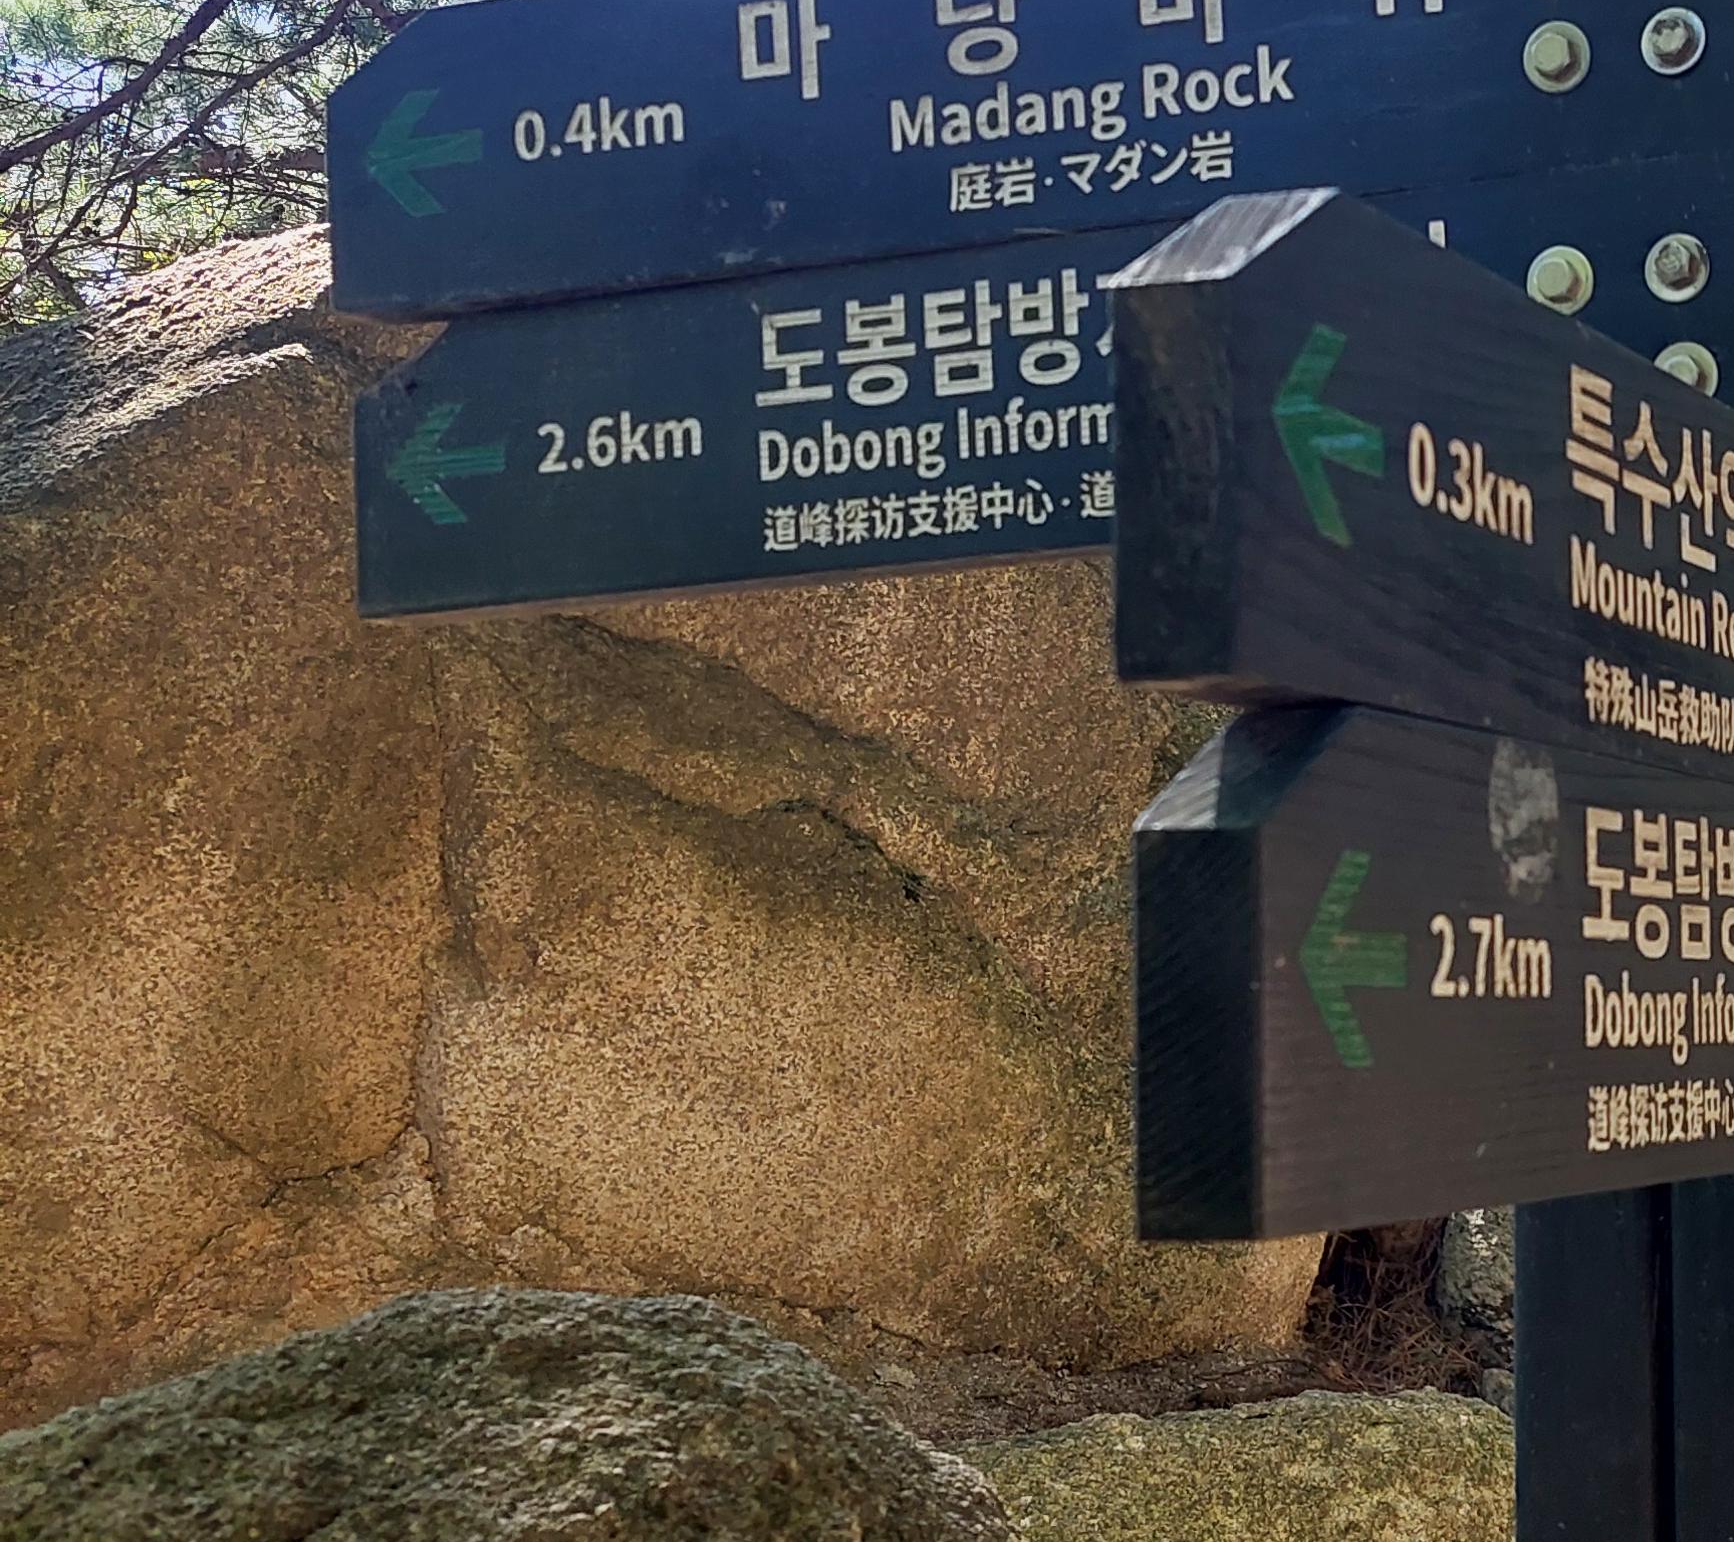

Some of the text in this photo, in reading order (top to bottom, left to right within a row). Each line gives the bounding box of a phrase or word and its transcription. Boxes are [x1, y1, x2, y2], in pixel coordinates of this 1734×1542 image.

[513, 95, 685, 161] 0.4km
[889, 44, 1295, 153] Madang Rock
[754, 267, 1115, 408] 도봉탐방
[537, 410, 703, 475] 2.6km
[757, 395, 1116, 483] Dobong Inform
[1408, 421, 1534, 546] 0.3km
[763, 469, 1116, 552] 道峰探访支援中心·道
[1569, 534, 1707, 652] Mountain
[1429, 912, 1553, 1000] 2.7km
[1583, 970, 1690, 1067] Dobong
